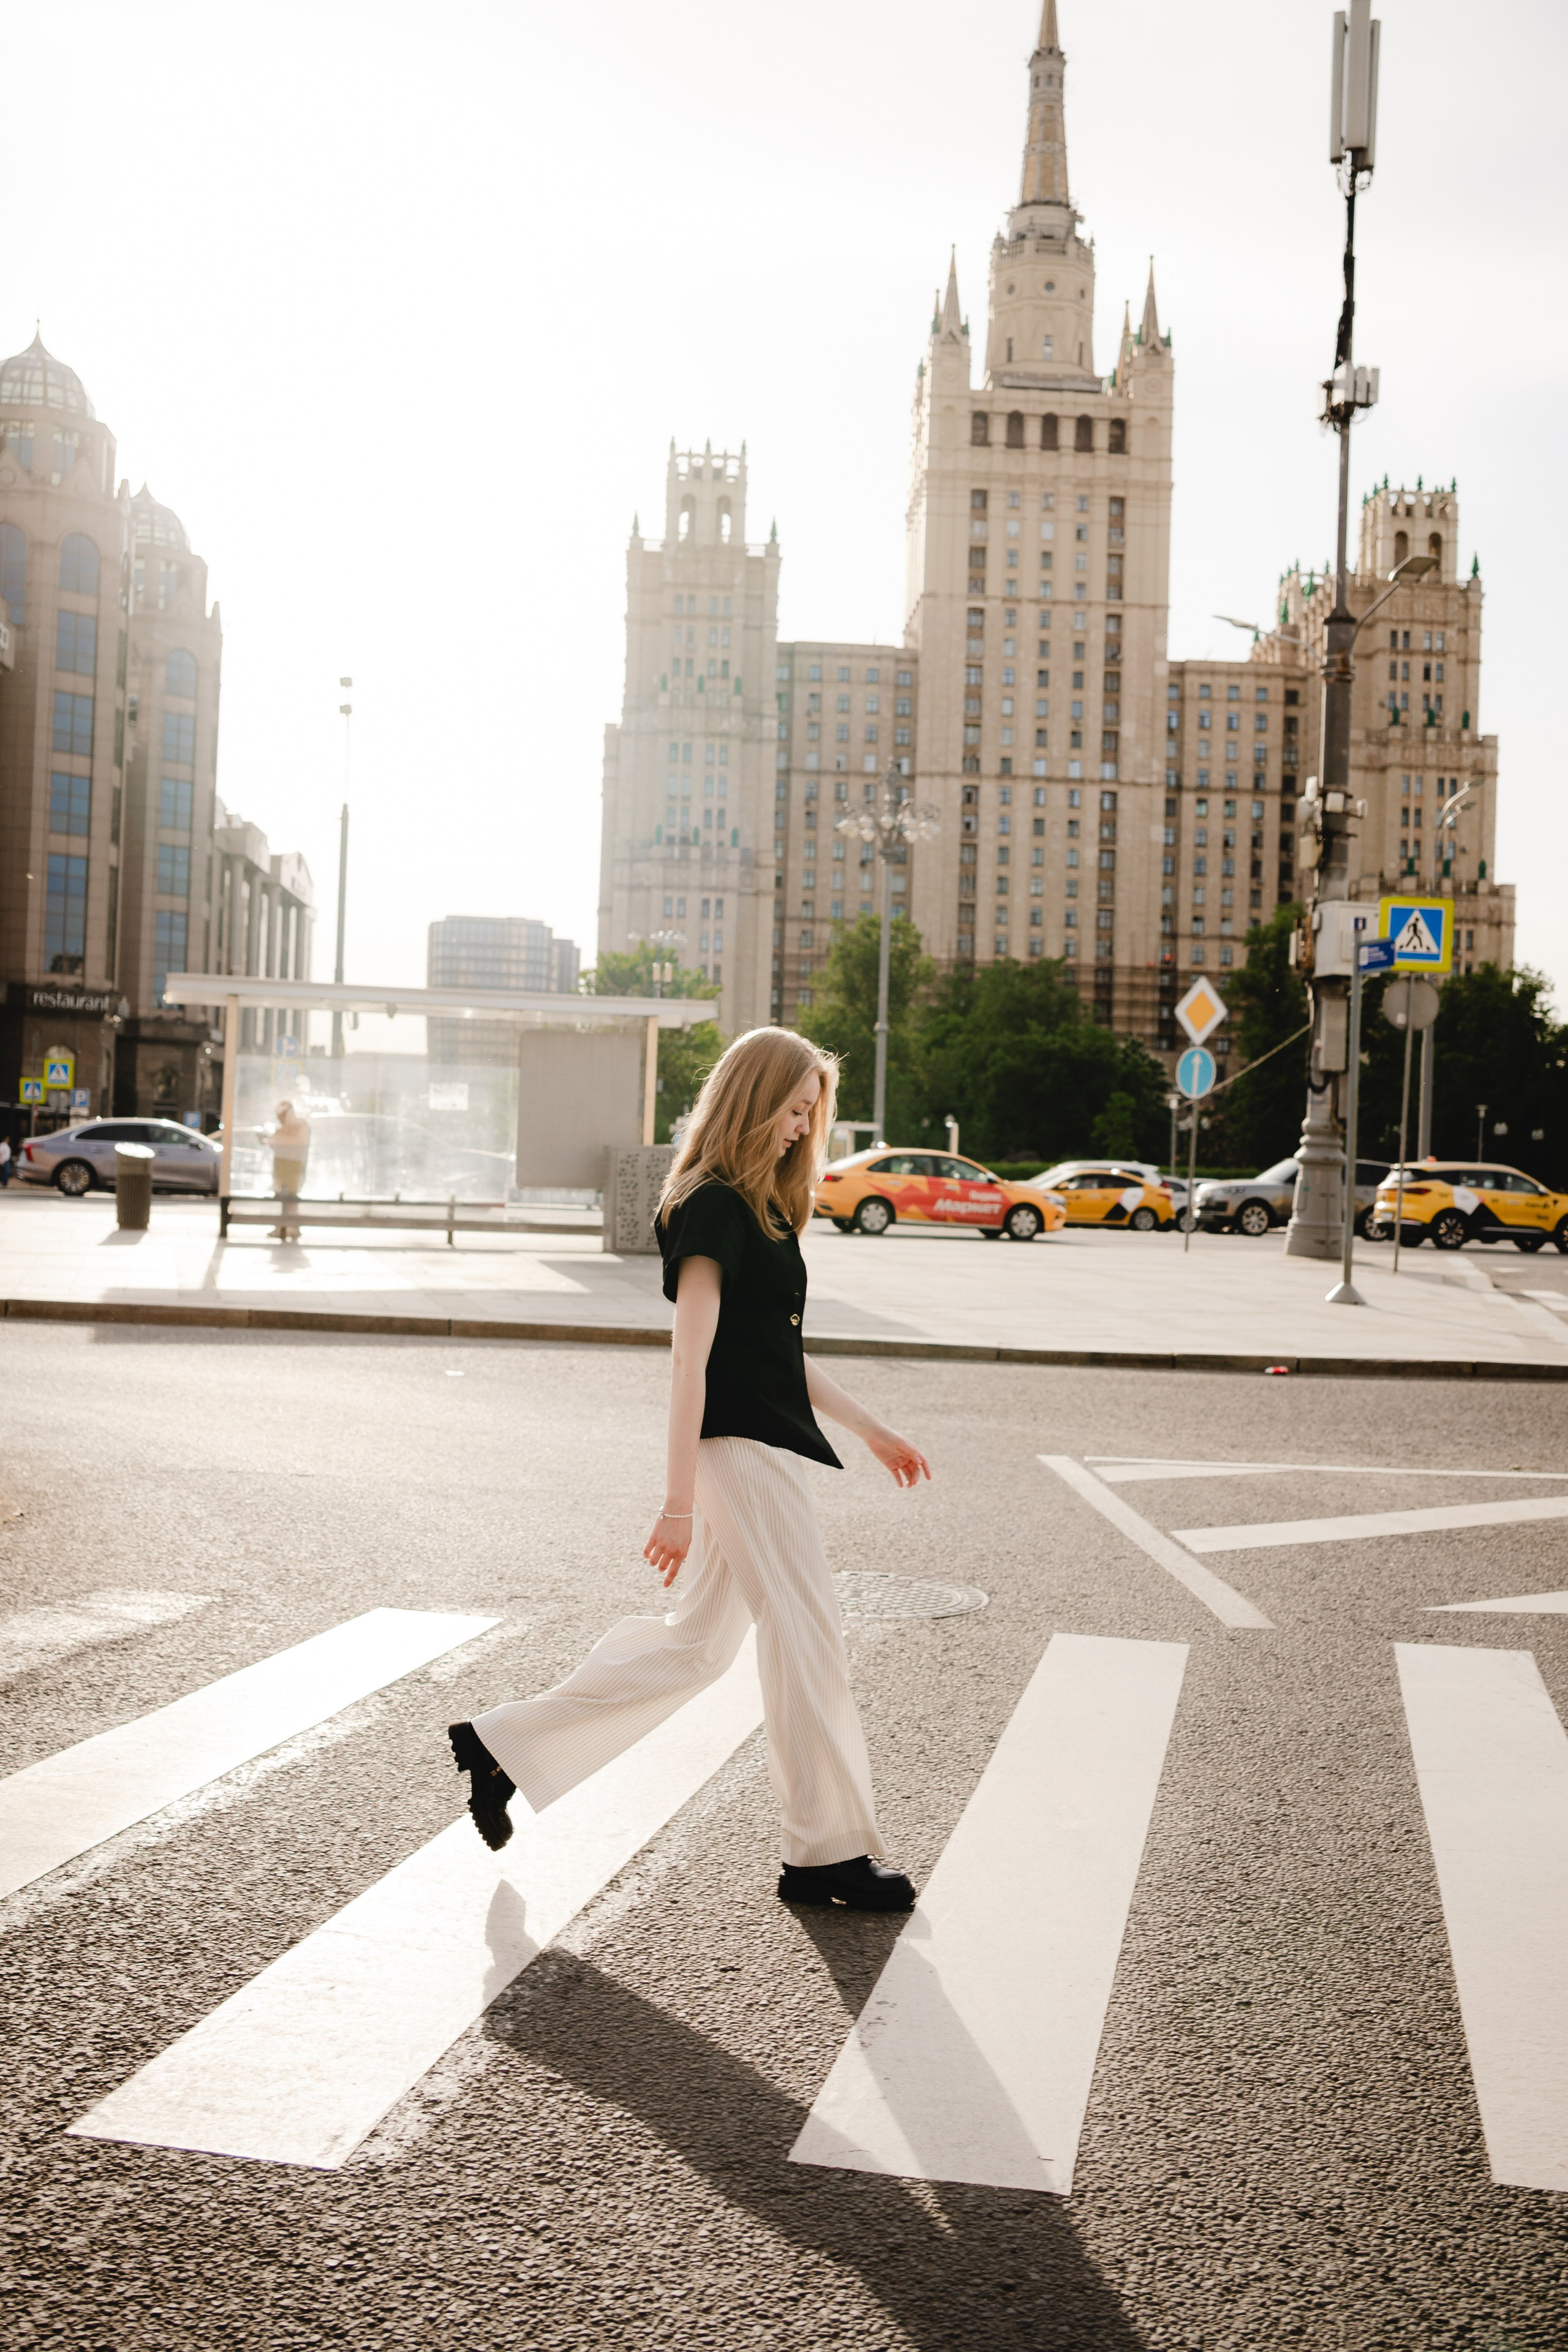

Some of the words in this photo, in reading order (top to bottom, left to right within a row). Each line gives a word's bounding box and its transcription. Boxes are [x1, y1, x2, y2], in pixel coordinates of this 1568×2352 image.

[33, 991, 110, 1011] restaurant
[75, 1090, 86, 1106] P
[933, 1198, 1002, 1215] Маркет
